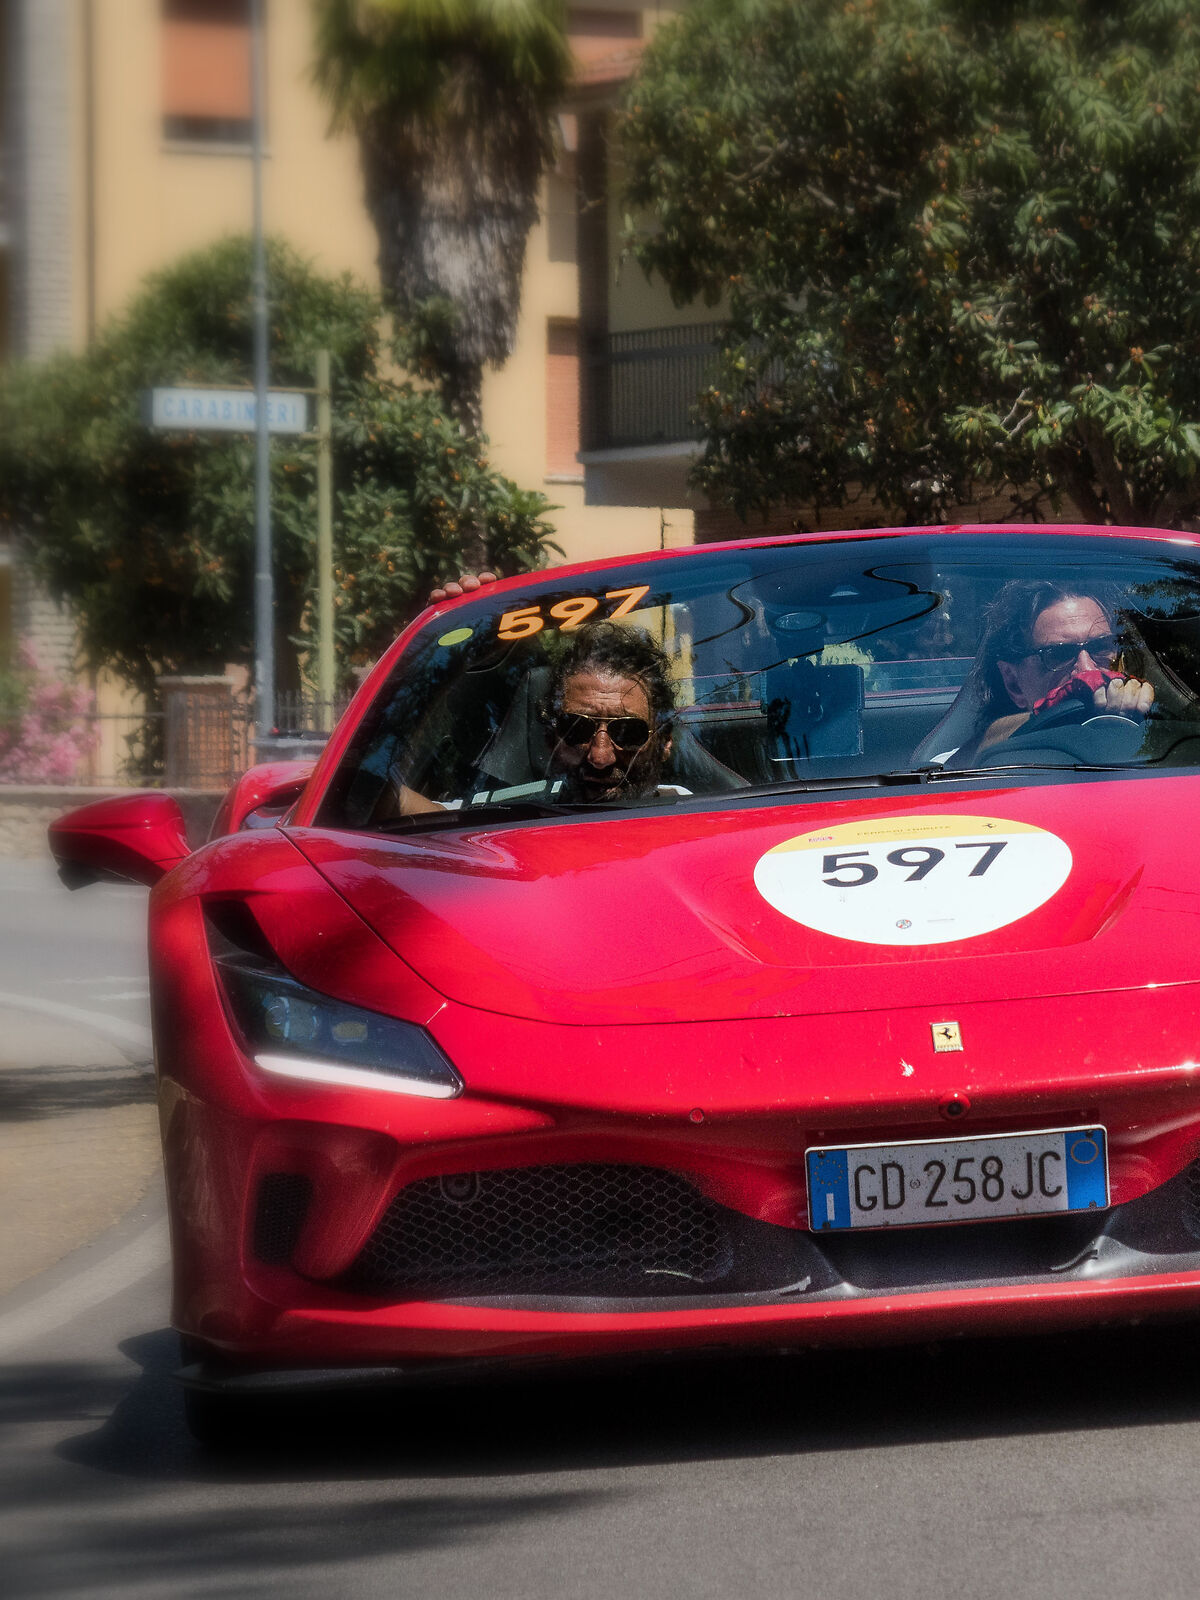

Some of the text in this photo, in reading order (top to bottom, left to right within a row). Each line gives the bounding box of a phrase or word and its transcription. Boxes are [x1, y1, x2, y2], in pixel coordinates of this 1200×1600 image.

[163, 397, 297, 424] CARABINERI
[497, 585, 650, 640] 597
[821, 841, 1008, 888] 597
[854, 1162, 906, 1211] GD
